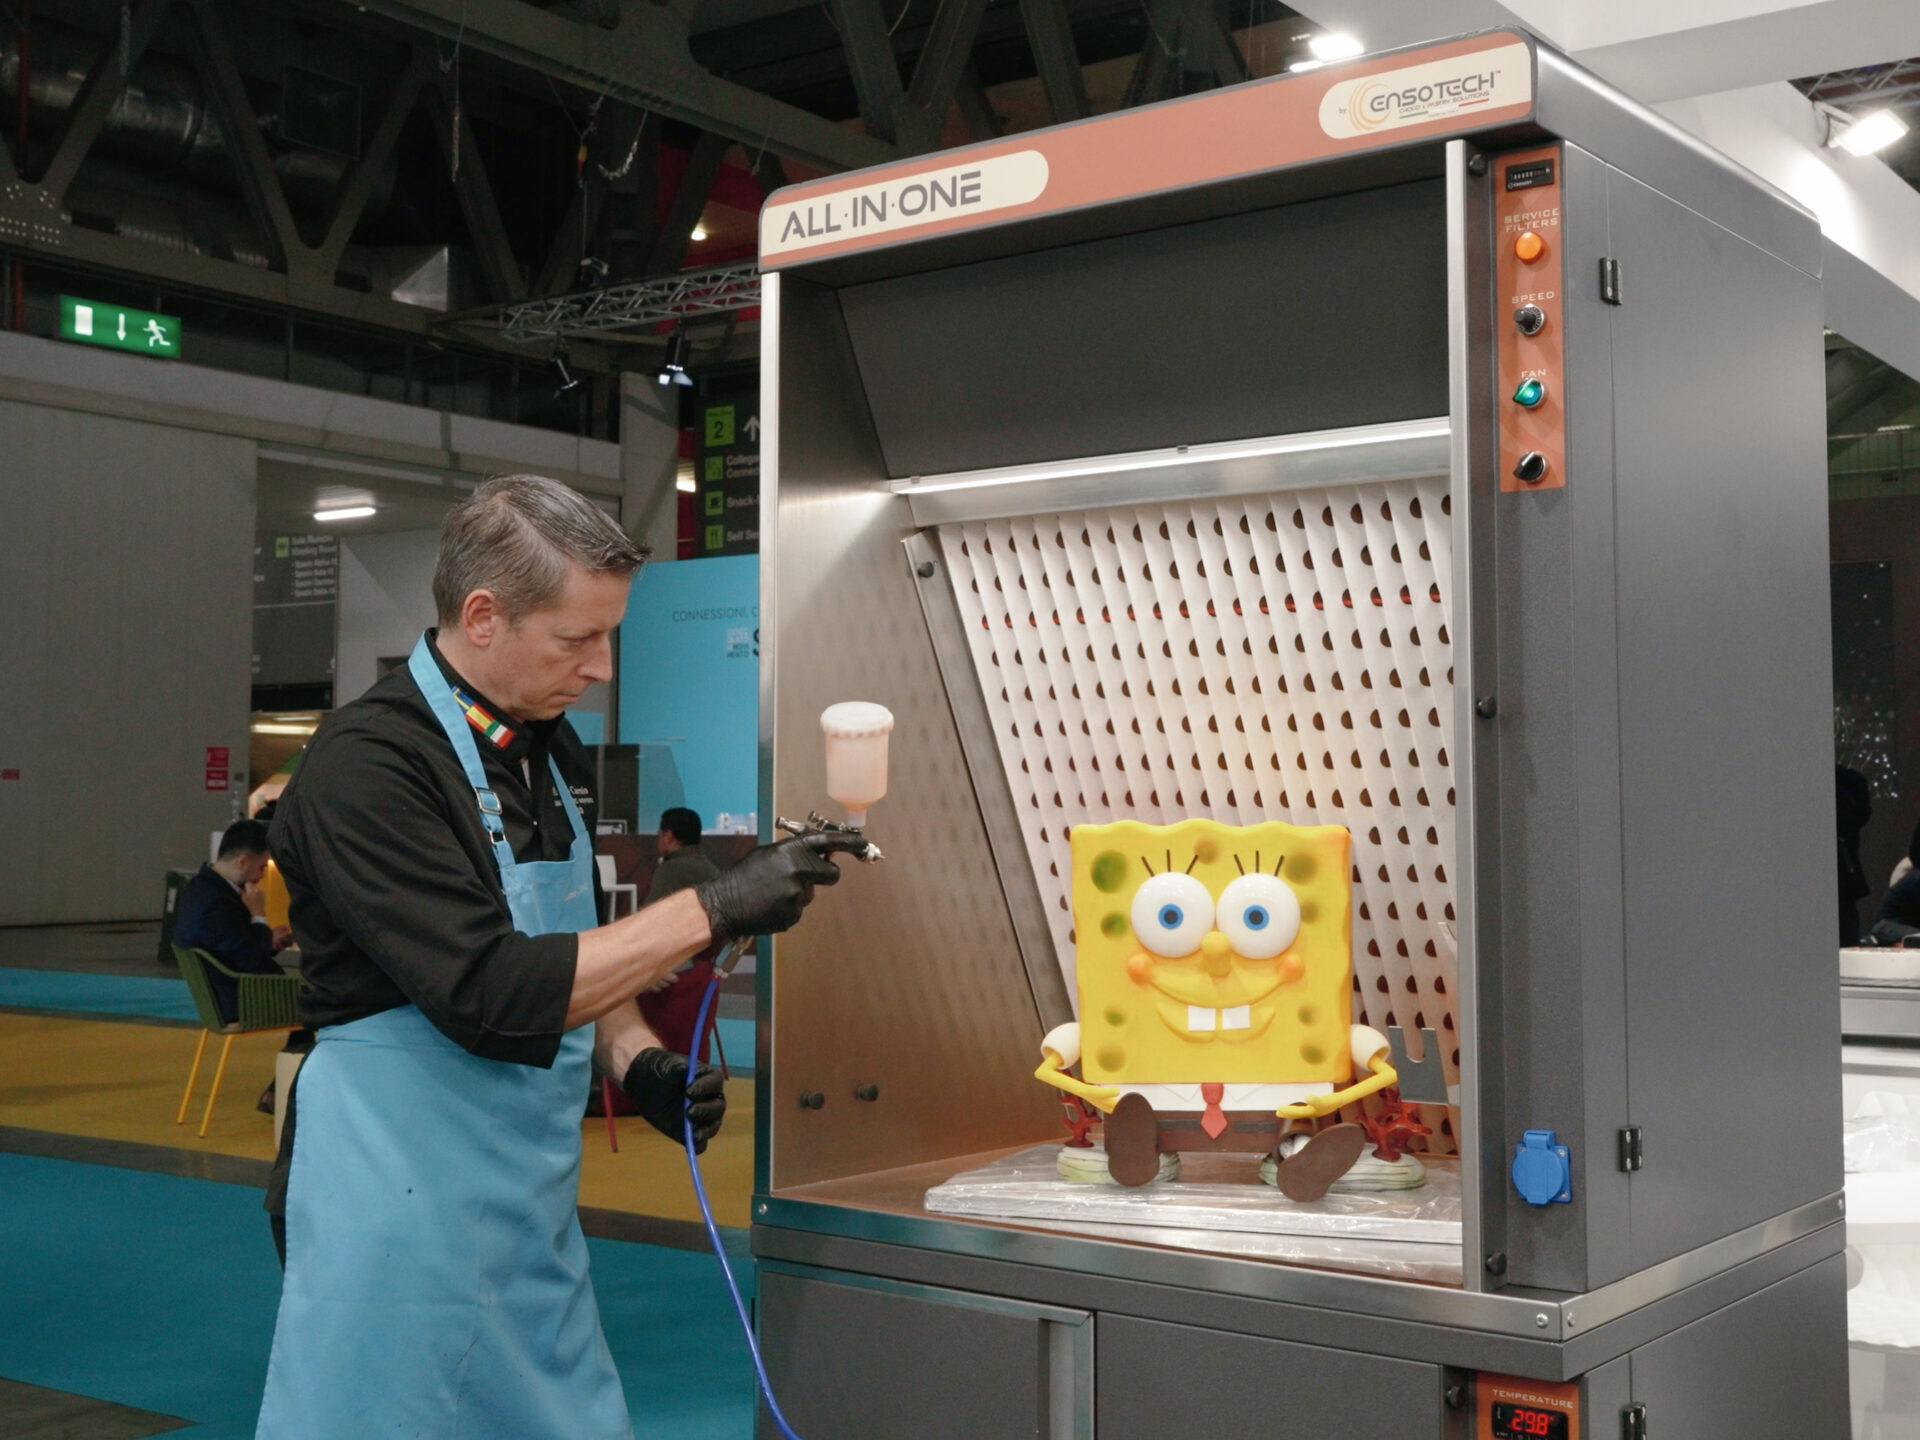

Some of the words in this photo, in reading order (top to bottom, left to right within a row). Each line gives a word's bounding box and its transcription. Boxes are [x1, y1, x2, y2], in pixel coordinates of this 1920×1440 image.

[1452, 91, 1490, 104] SOLUTIONS
[1504, 208, 1560, 224] SERVICE
[1505, 217, 1558, 232] FILTERS
[1511, 291, 1555, 304] SPEED
[1521, 368, 1547, 378] FAN
[714, 421, 724, 439] 2
[1492, 1388, 1574, 1408] TEMPERATURE
